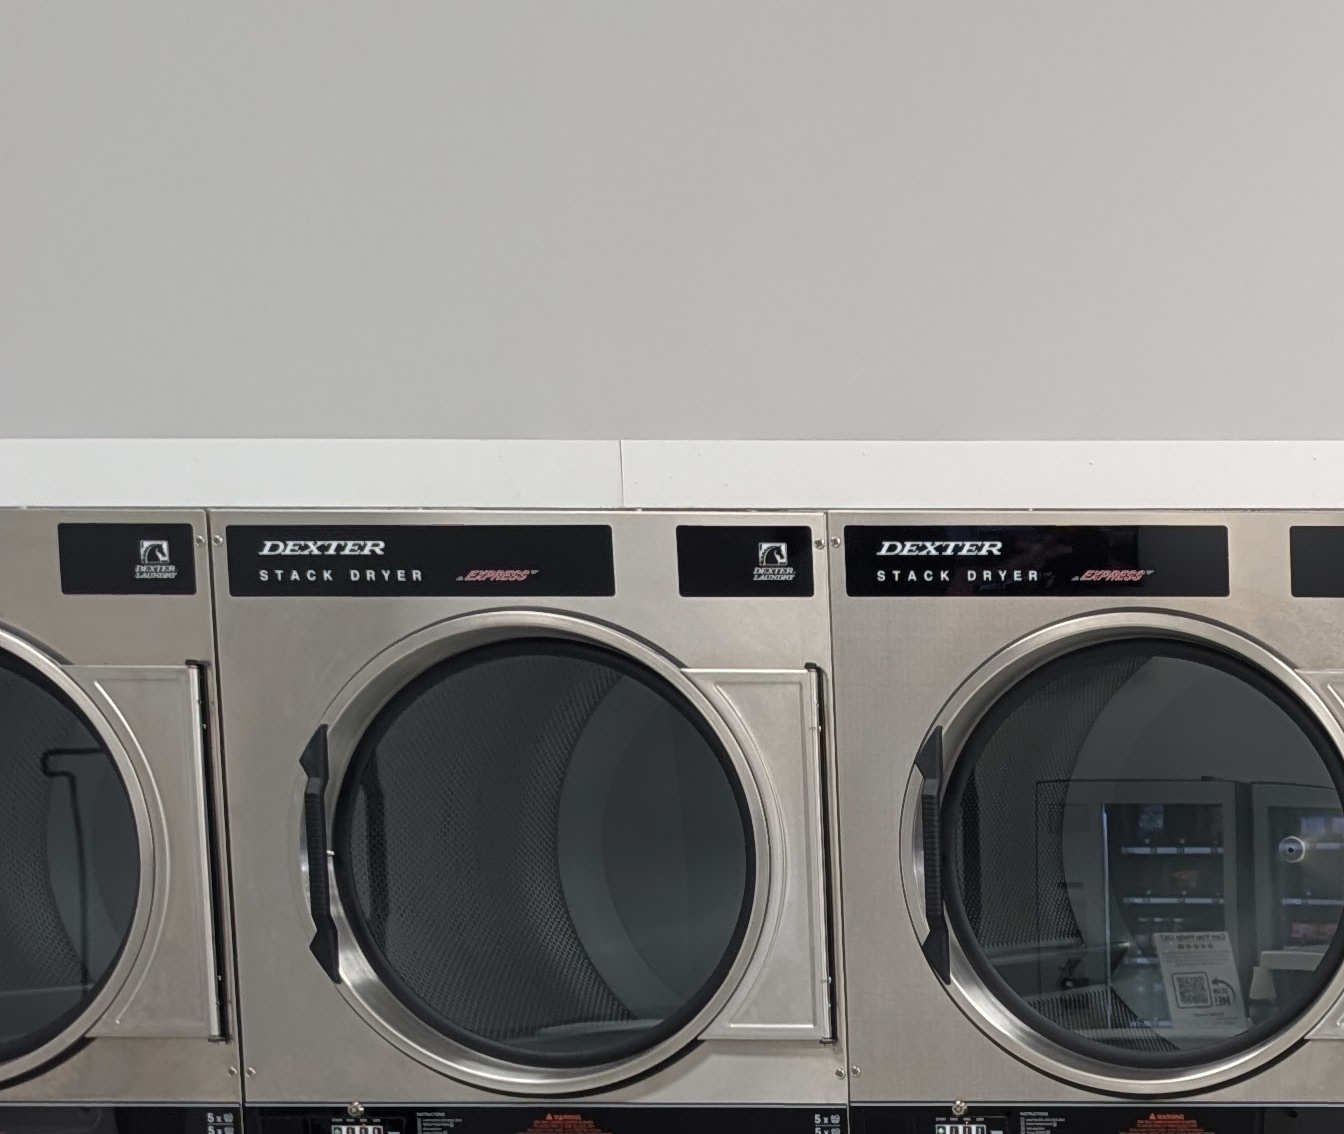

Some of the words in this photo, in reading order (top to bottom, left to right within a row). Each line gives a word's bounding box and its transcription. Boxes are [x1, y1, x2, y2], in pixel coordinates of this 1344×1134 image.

[258, 540, 386, 556] DEXTER
[876, 540, 1003, 556] DEXTER
[135, 565, 176, 573] DEXTER
[464, 569, 531, 581] EXPRESS
[753, 567, 795, 575] DEXTER
[1080, 569, 1146, 581] EXPRESS
[259, 569, 333, 582] STACK
[349, 569, 422, 582] DRYER
[876, 569, 950, 582] STACK
[967, 569, 1038, 582] DRYER
[207, 1112, 215, 1123] 5
[216, 1115, 222, 1123] x
[814, 1113, 822, 1124] 5
[823, 1116, 829, 1124] x
